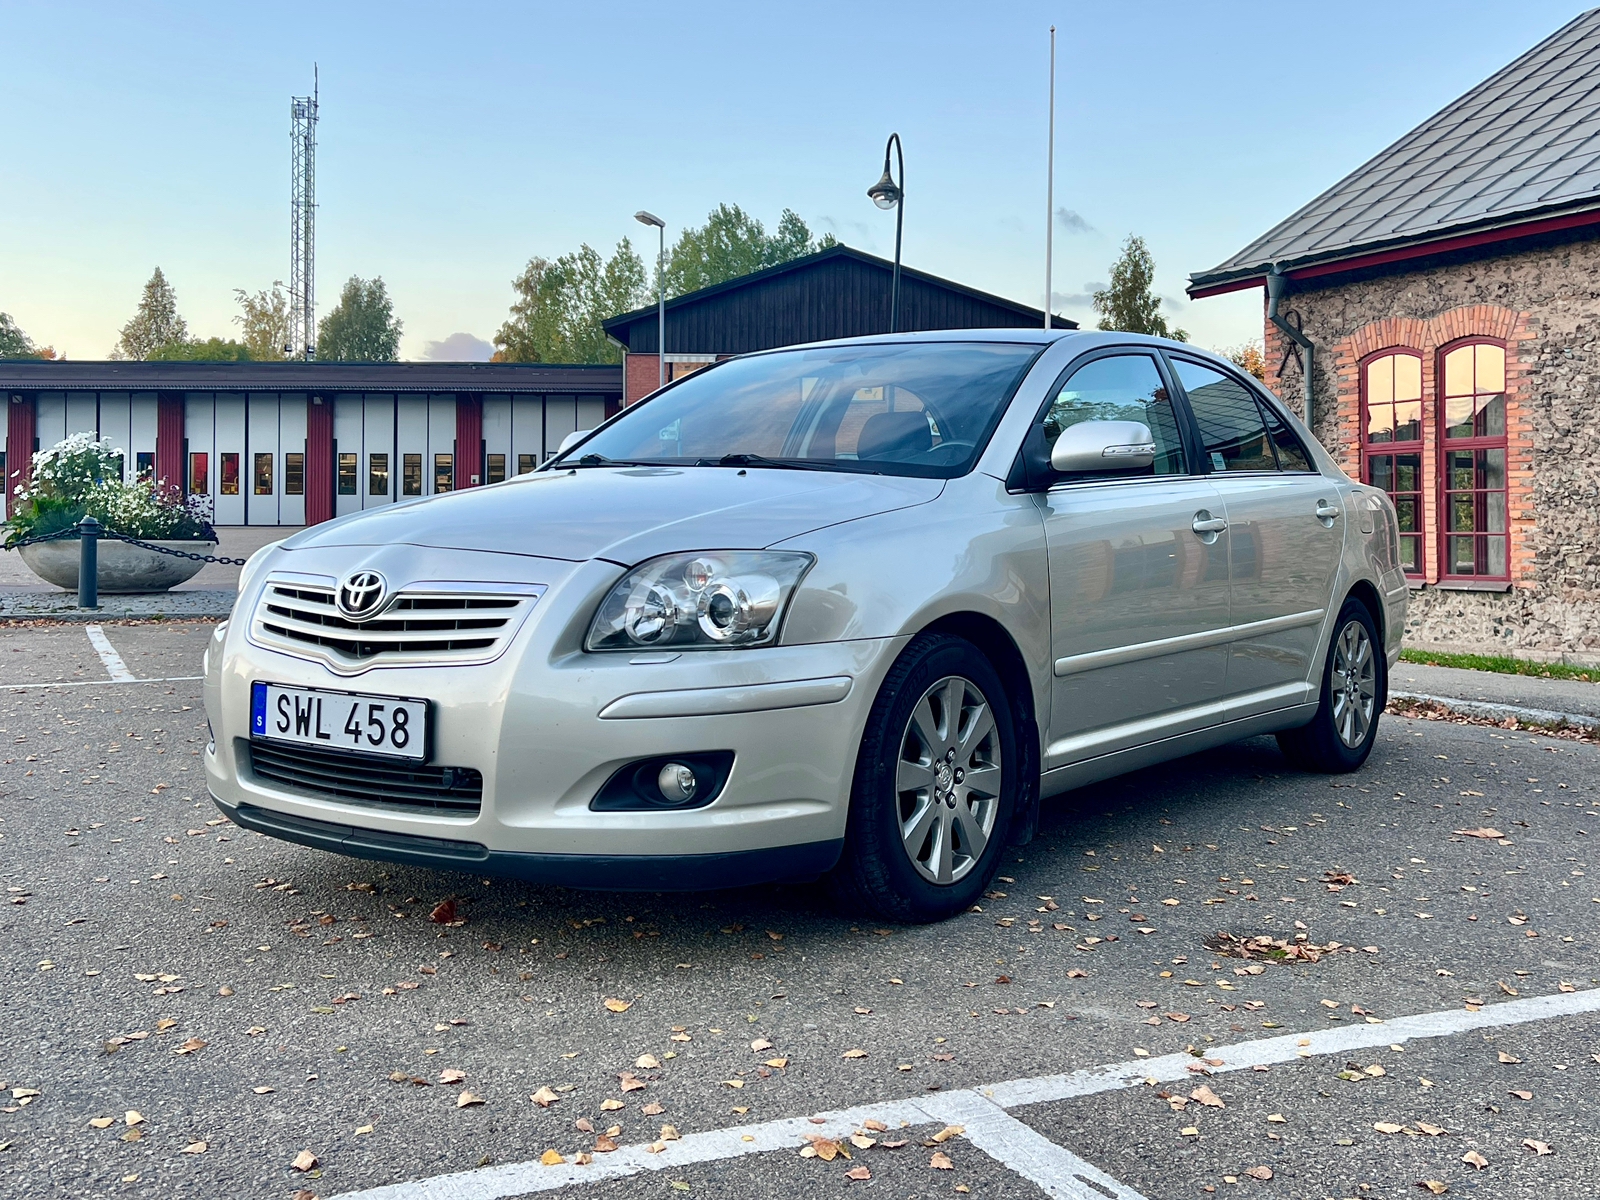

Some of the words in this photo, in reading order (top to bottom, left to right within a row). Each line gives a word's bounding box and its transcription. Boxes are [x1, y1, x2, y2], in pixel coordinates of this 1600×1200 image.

[256, 715, 263, 727] S
[276, 693, 331, 740] SWL
[344, 702, 410, 749] 458
